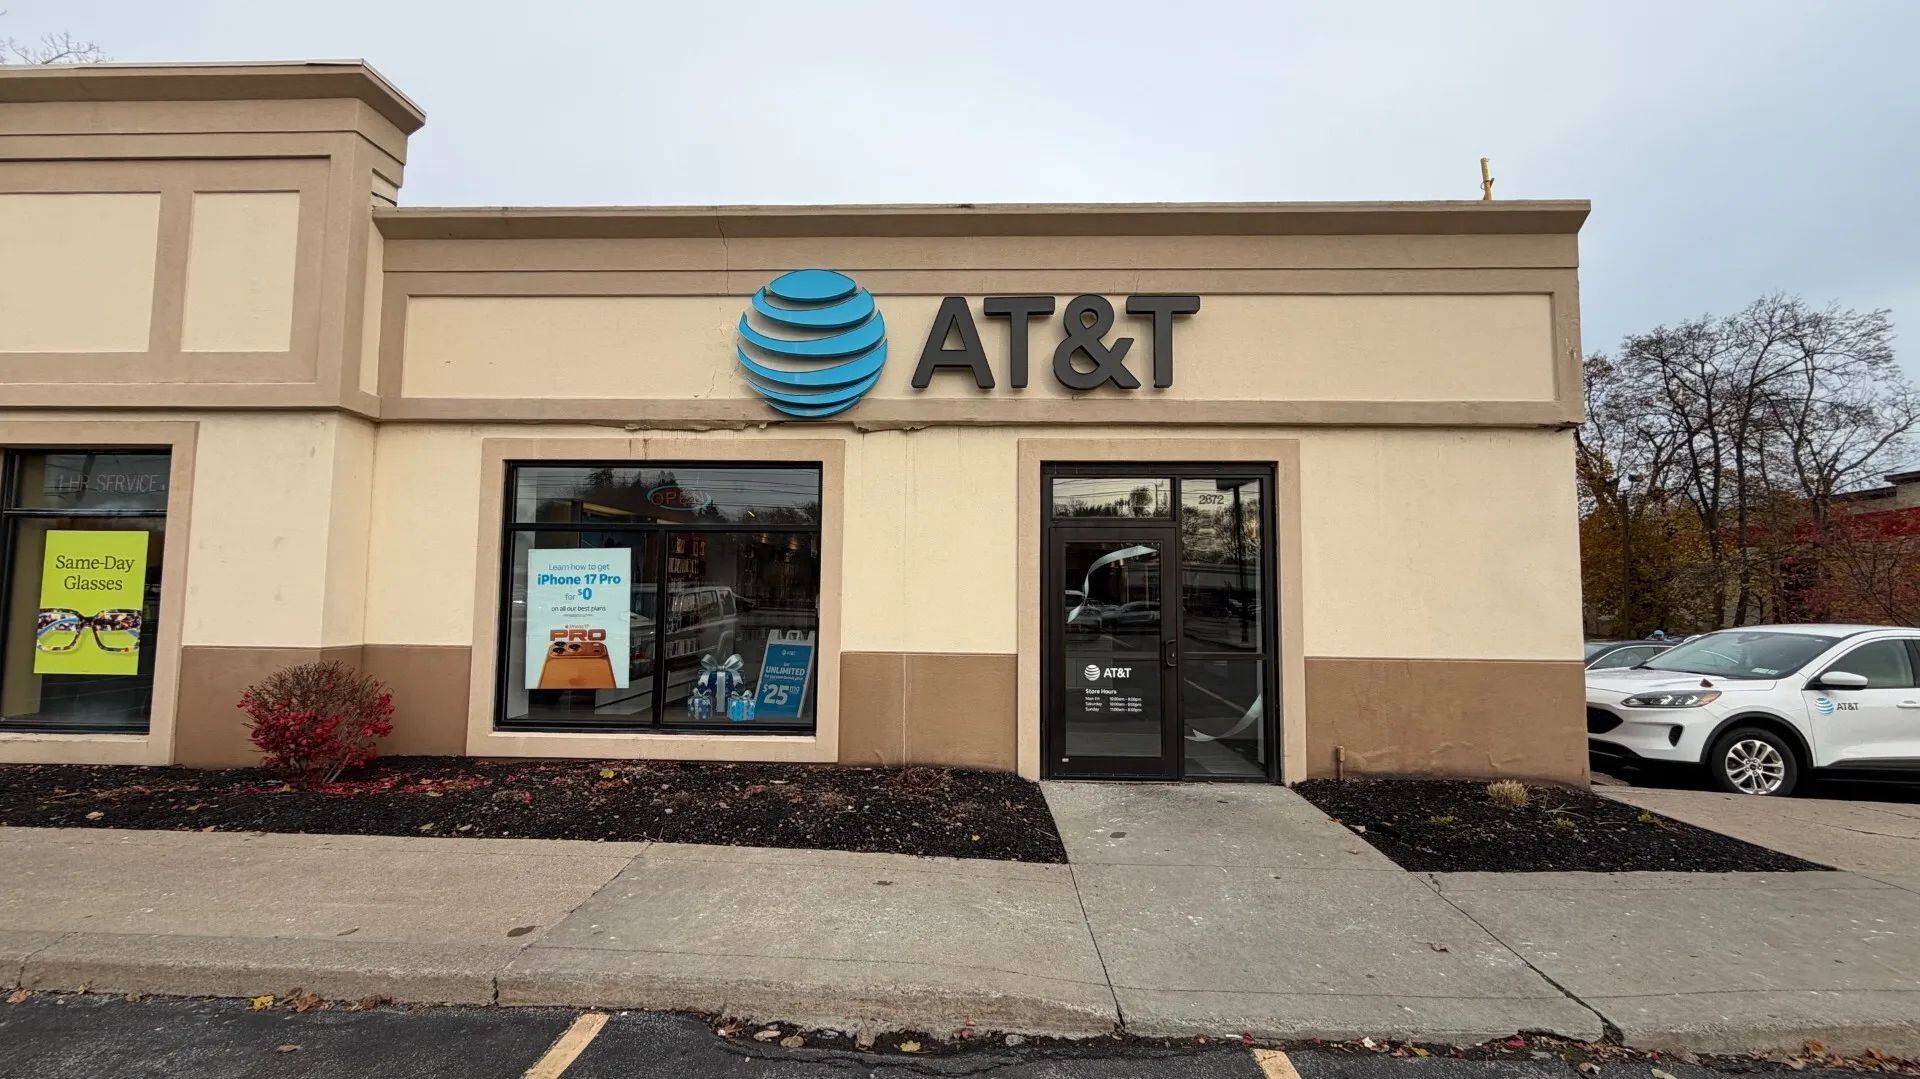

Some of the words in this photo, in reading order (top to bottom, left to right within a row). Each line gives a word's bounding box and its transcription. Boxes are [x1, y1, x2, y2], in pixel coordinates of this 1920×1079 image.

[911, 293, 1201, 390] AT&T
[651, 490, 706, 506] OPEN
[1198, 494, 1225, 506] 2672
[55, 555, 136, 574] Same-Day
[598, 564, 610, 572] get
[64, 575, 123, 591] Glasses
[537, 574, 581, 585] iPhone
[584, 574, 597, 585] 17
[599, 574, 621, 585] Pro
[565, 592, 576, 601] for
[578, 588, 592, 600] $0
[550, 628, 606, 642] PRO
[766, 666, 805, 676] UNLIMITED
[1103, 668, 1132, 678] AT&T
[762, 684, 789, 705] $25
[1836, 702, 1860, 711] AT&T
